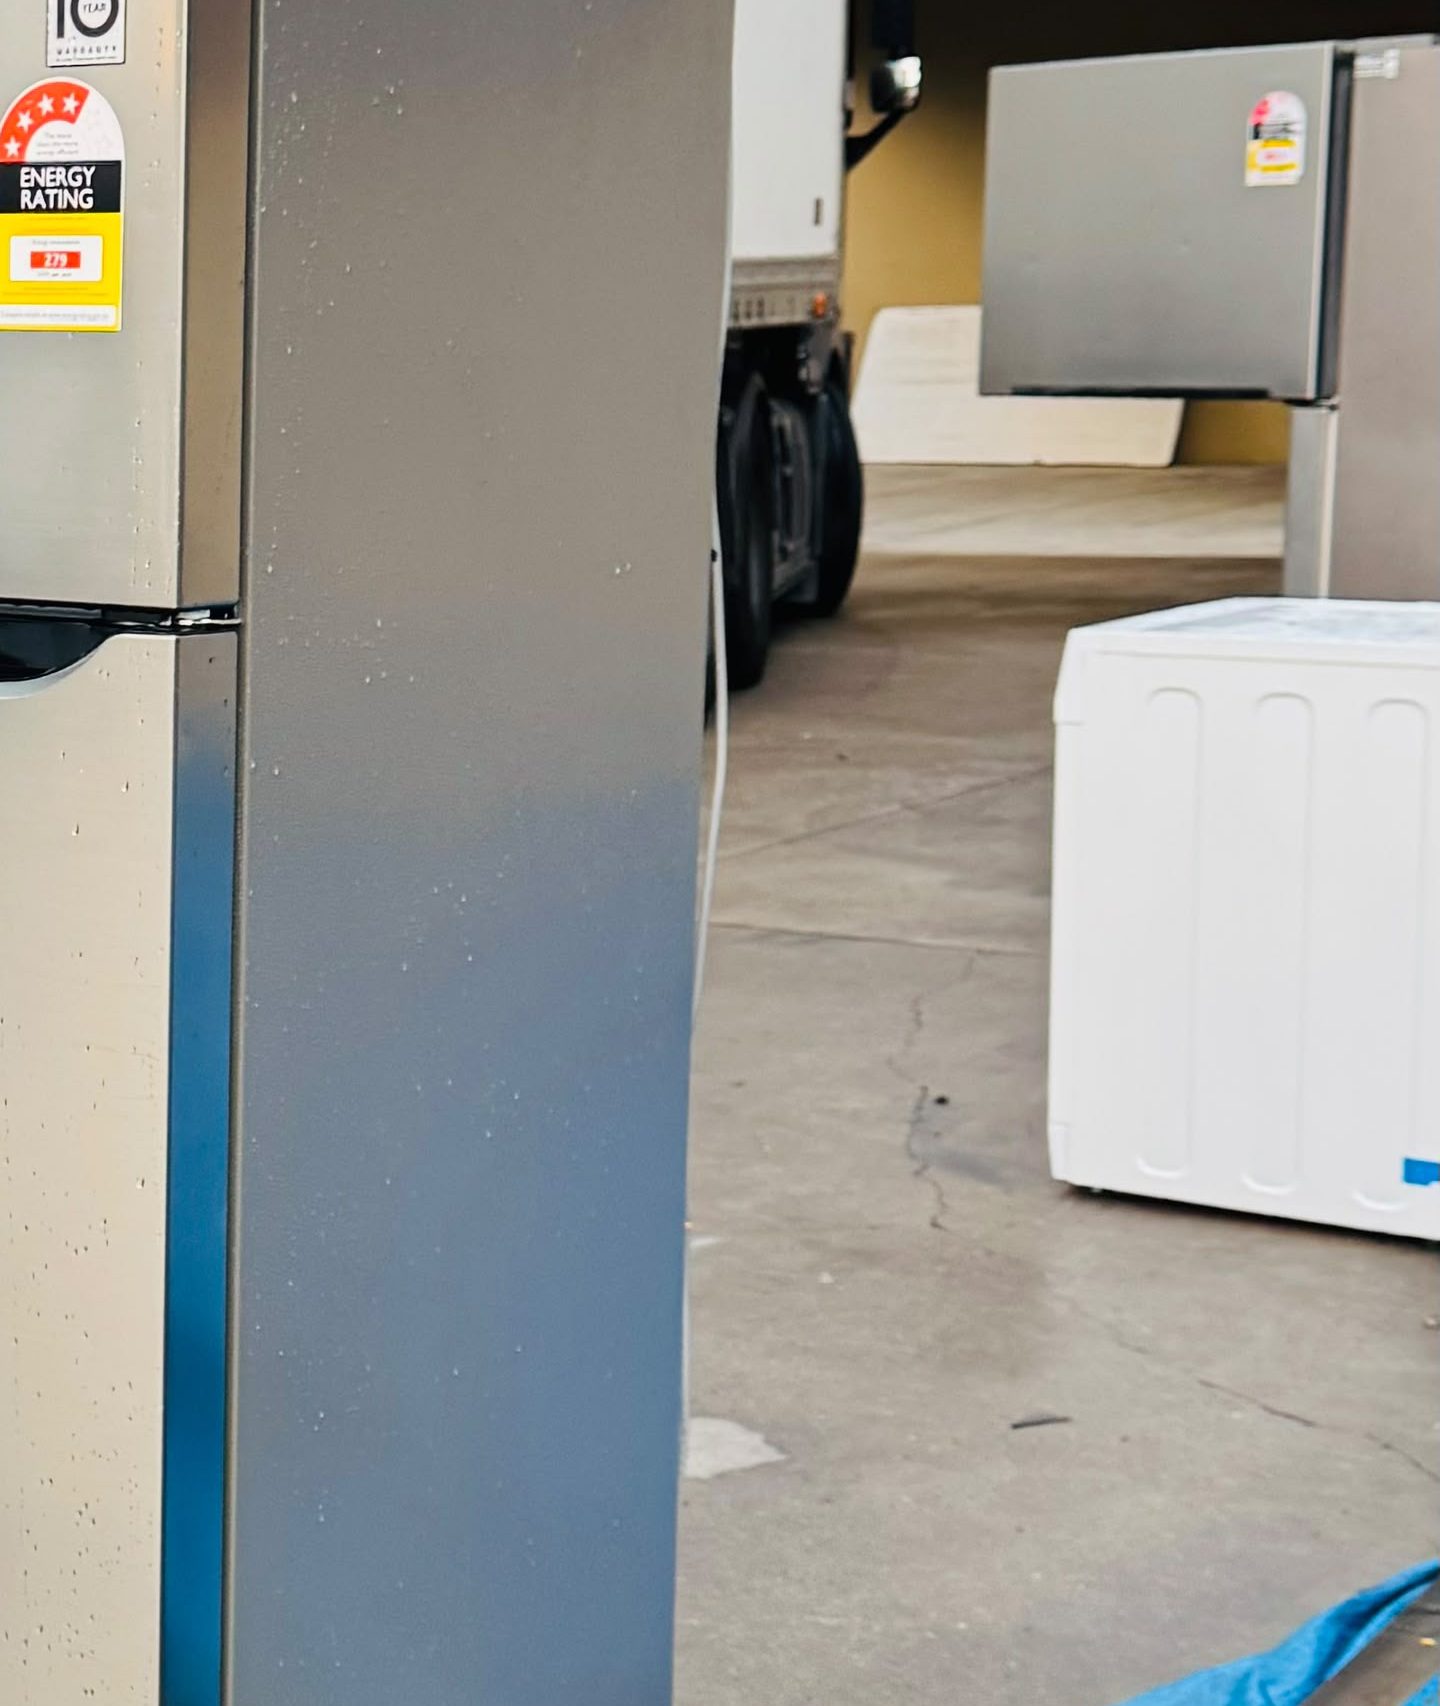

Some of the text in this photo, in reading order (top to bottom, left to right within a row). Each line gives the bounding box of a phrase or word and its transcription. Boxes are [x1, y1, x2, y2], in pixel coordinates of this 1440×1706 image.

[20, 166, 96, 188] ENERGY
[20, 188, 94, 210] RATING
[43, 252, 68, 268] 279
